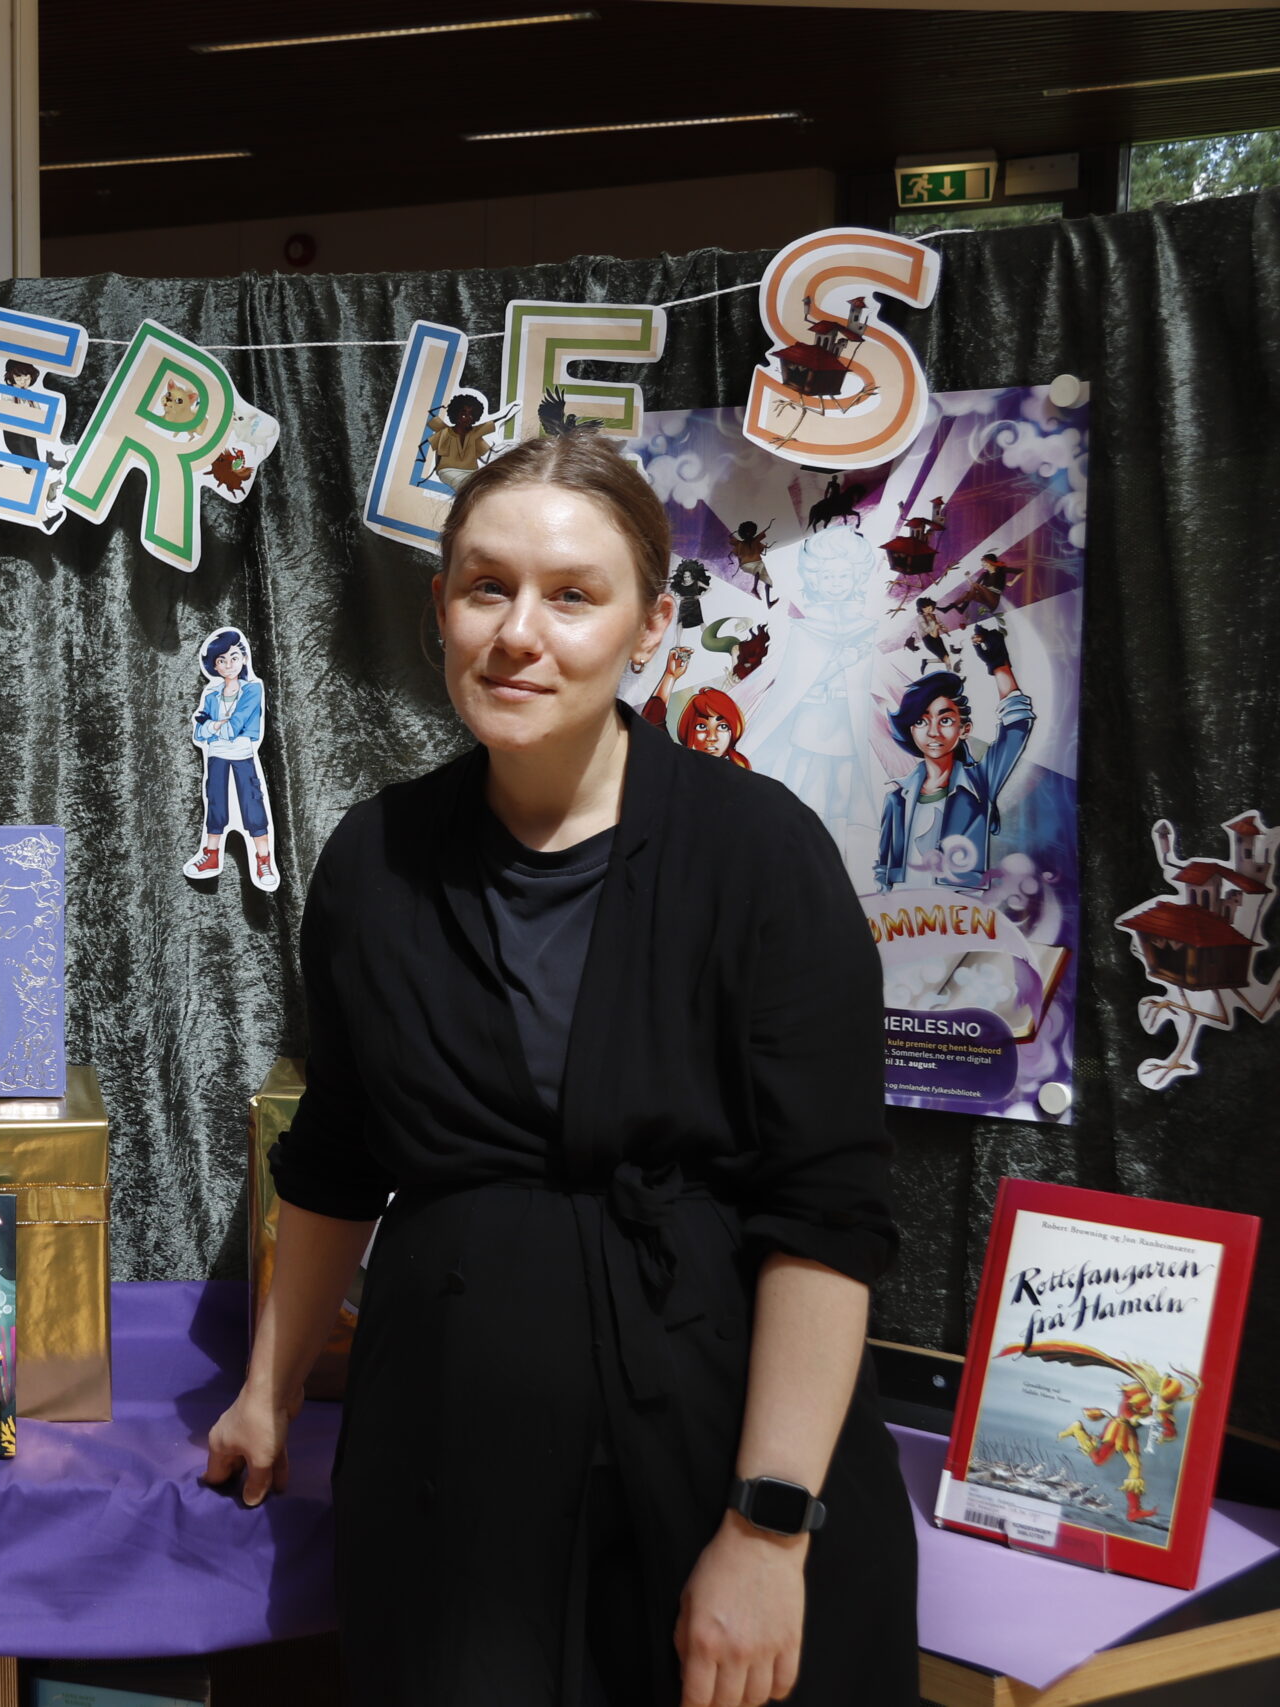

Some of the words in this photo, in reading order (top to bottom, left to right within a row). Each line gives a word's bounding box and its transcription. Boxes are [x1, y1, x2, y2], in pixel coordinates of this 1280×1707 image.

[867, 904, 997, 944] MMEN
[884, 1016, 981, 1037] ERLES.NO
[887, 1038, 905, 1047] kule
[905, 1040, 936, 1049] premier
[937, 1043, 948, 1052] og
[948, 1043, 967, 1052] hent
[968, 1045, 1002, 1055] kodeord
[891, 1048, 945, 1060] Sommerles.no
[966, 1055, 991, 1065] digital
[908, 1060, 938, 1069] august.
[1041, 1220, 1068, 1232] Robert
[1070, 1225, 1108, 1240] Browning
[1110, 1234, 1120, 1242] og
[1009, 1260, 1215, 1308] Rottefangaren
[1070, 1286, 1198, 1332] Hameln
